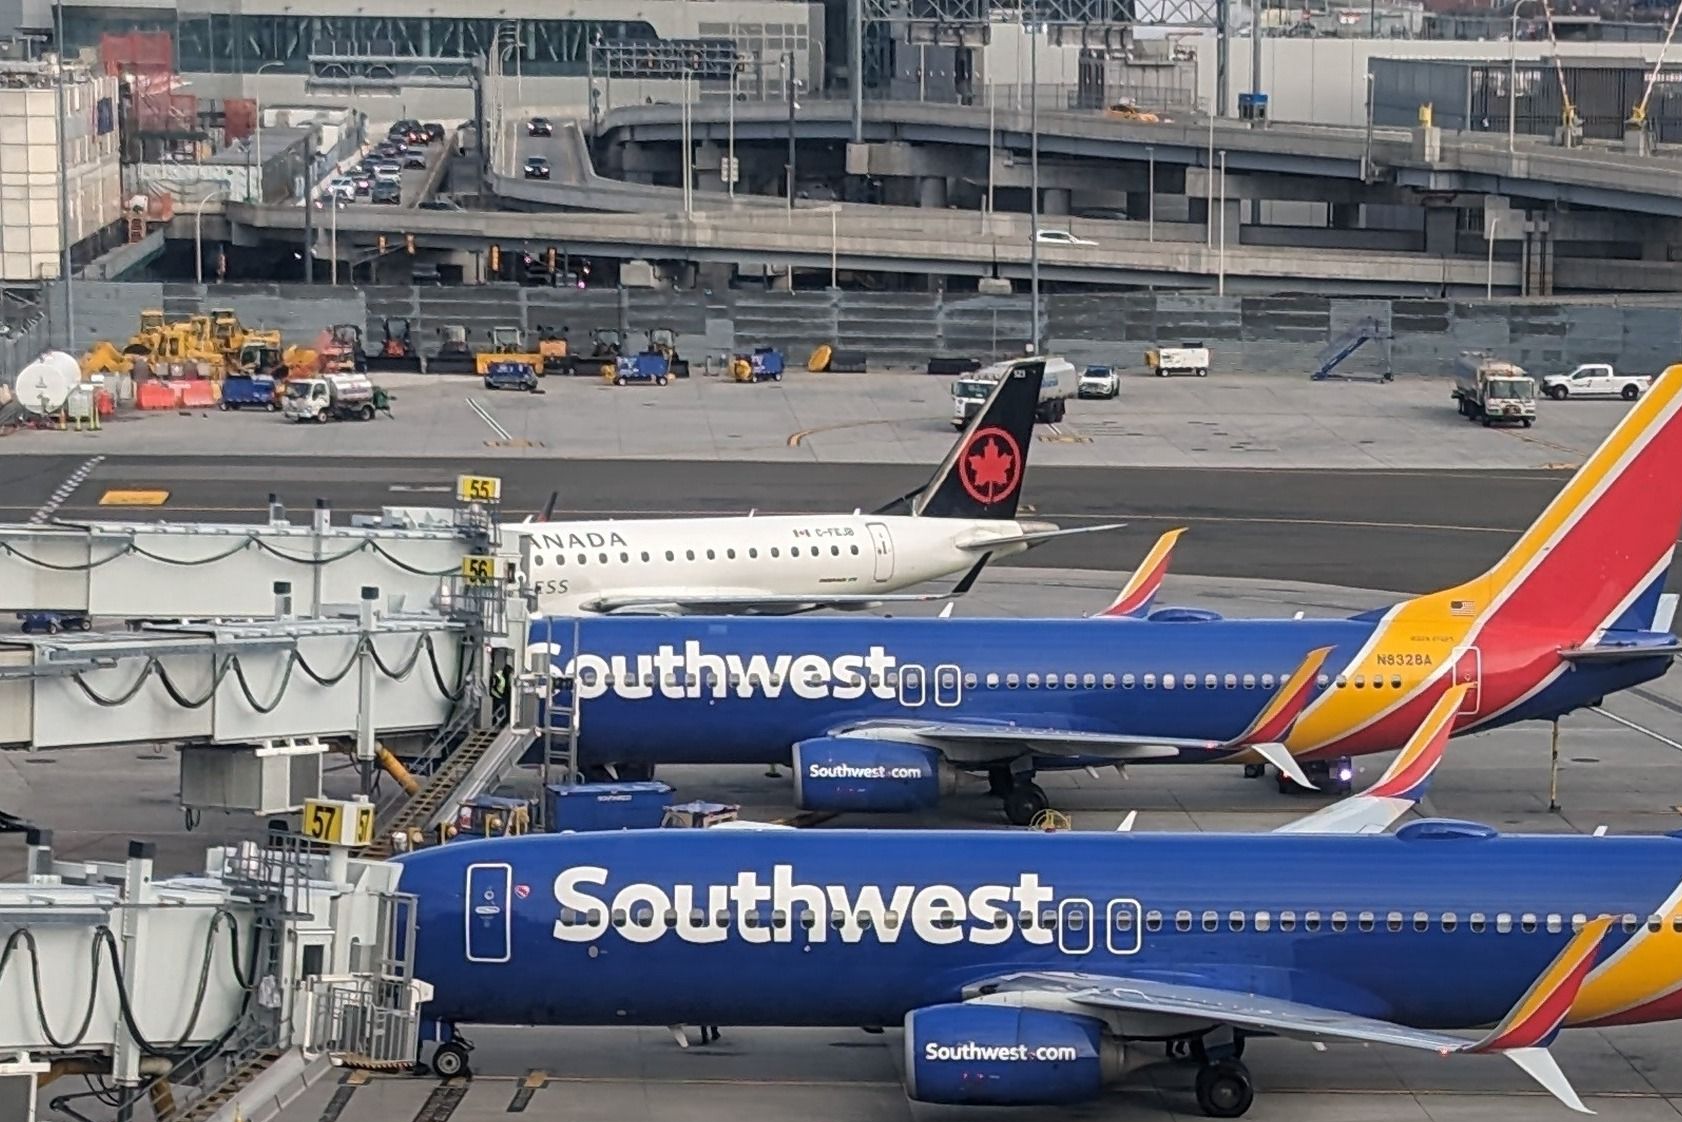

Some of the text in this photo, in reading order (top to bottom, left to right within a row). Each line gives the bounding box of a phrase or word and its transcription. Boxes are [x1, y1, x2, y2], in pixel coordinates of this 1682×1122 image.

[470, 480, 490, 499] 55
[469, 559, 488, 583] 56
[311, 805, 337, 841] 57
[358, 809, 370, 842] 57
[552, 864, 1055, 944] Southwest
